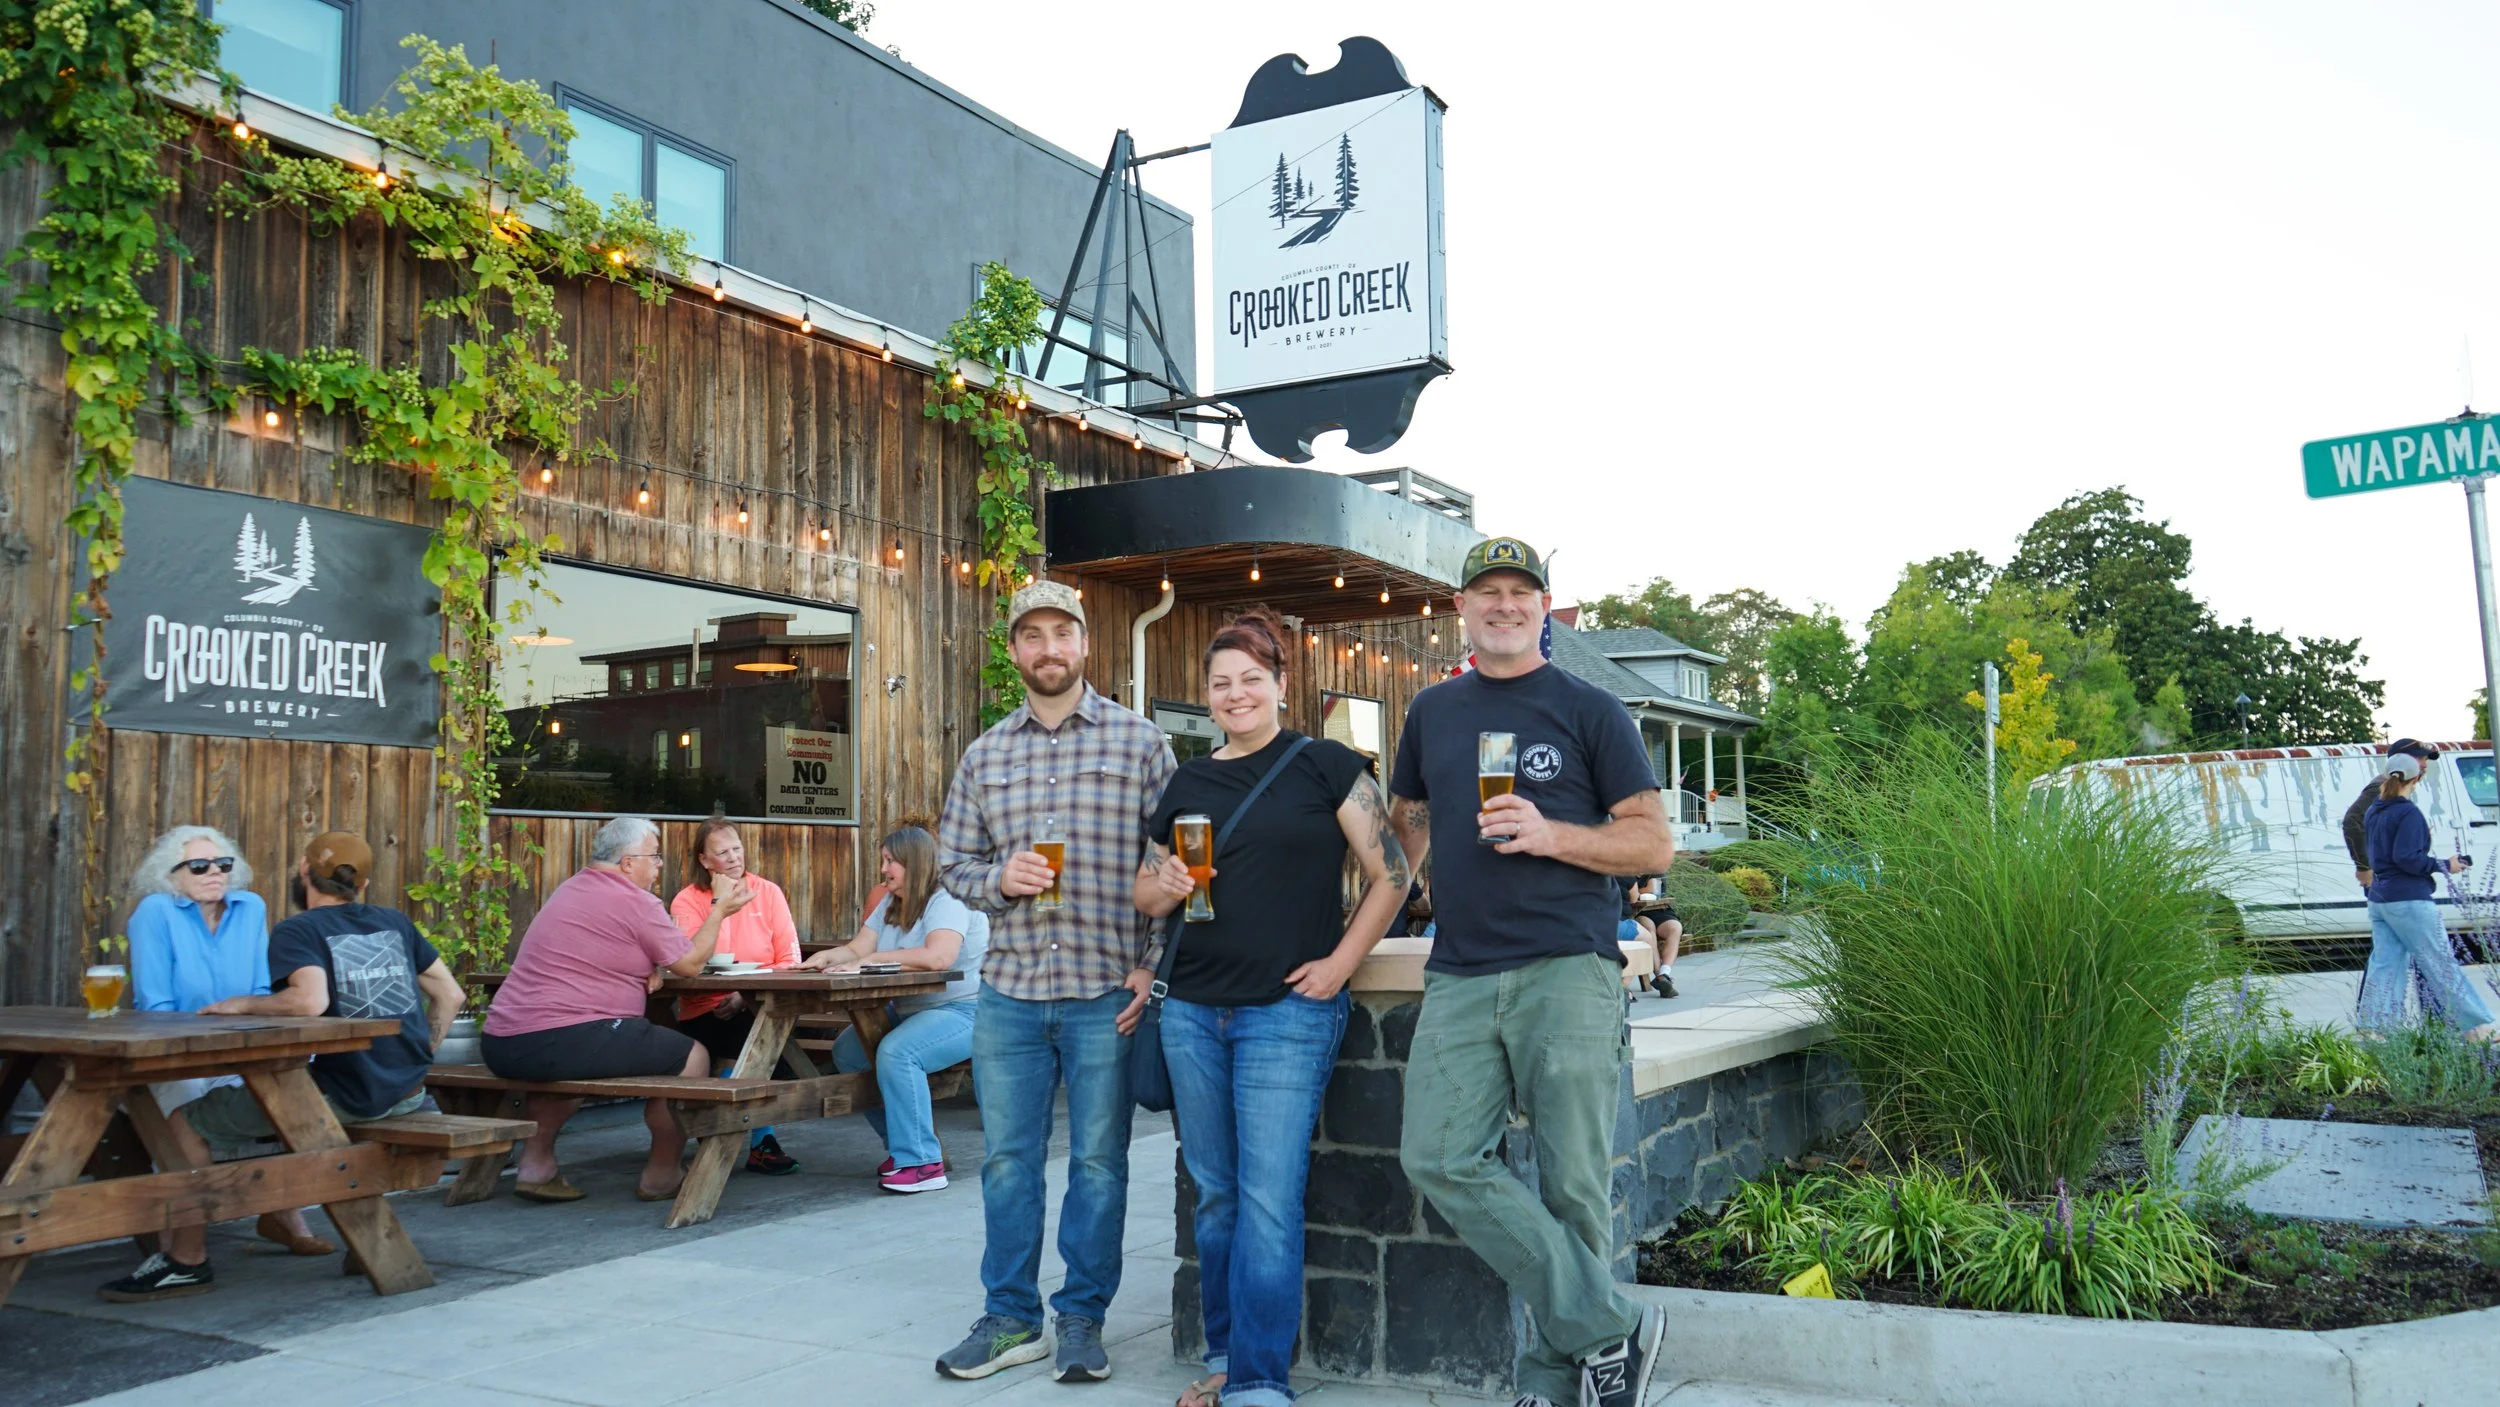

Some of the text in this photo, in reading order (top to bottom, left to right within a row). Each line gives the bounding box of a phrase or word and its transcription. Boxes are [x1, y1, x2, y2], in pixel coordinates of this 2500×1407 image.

[1281, 268, 1313, 281] COLUMBIA
[1315, 263, 1340, 272] COUNTY
[1229, 261, 1412, 348] CROOKED CREEK
[1285, 326, 1356, 346] BREWERY
[2330, 423, 2500, 488] WAPAMA
[223, 614, 268, 623] COLUMBIA
[270, 615, 304, 628] COUNTY
[144, 614, 388, 708] CROOKED CREEK
[225, 700, 320, 720] BREWERY
[817, 737, 833, 747] Our
[787, 748, 833, 762] Community
[793, 760, 827, 785] NO
[780, 785, 839, 796] DATA CENTERS
[805, 796, 815, 805] IN
[769, 805, 846, 816] COLUMBIA COUNTY
